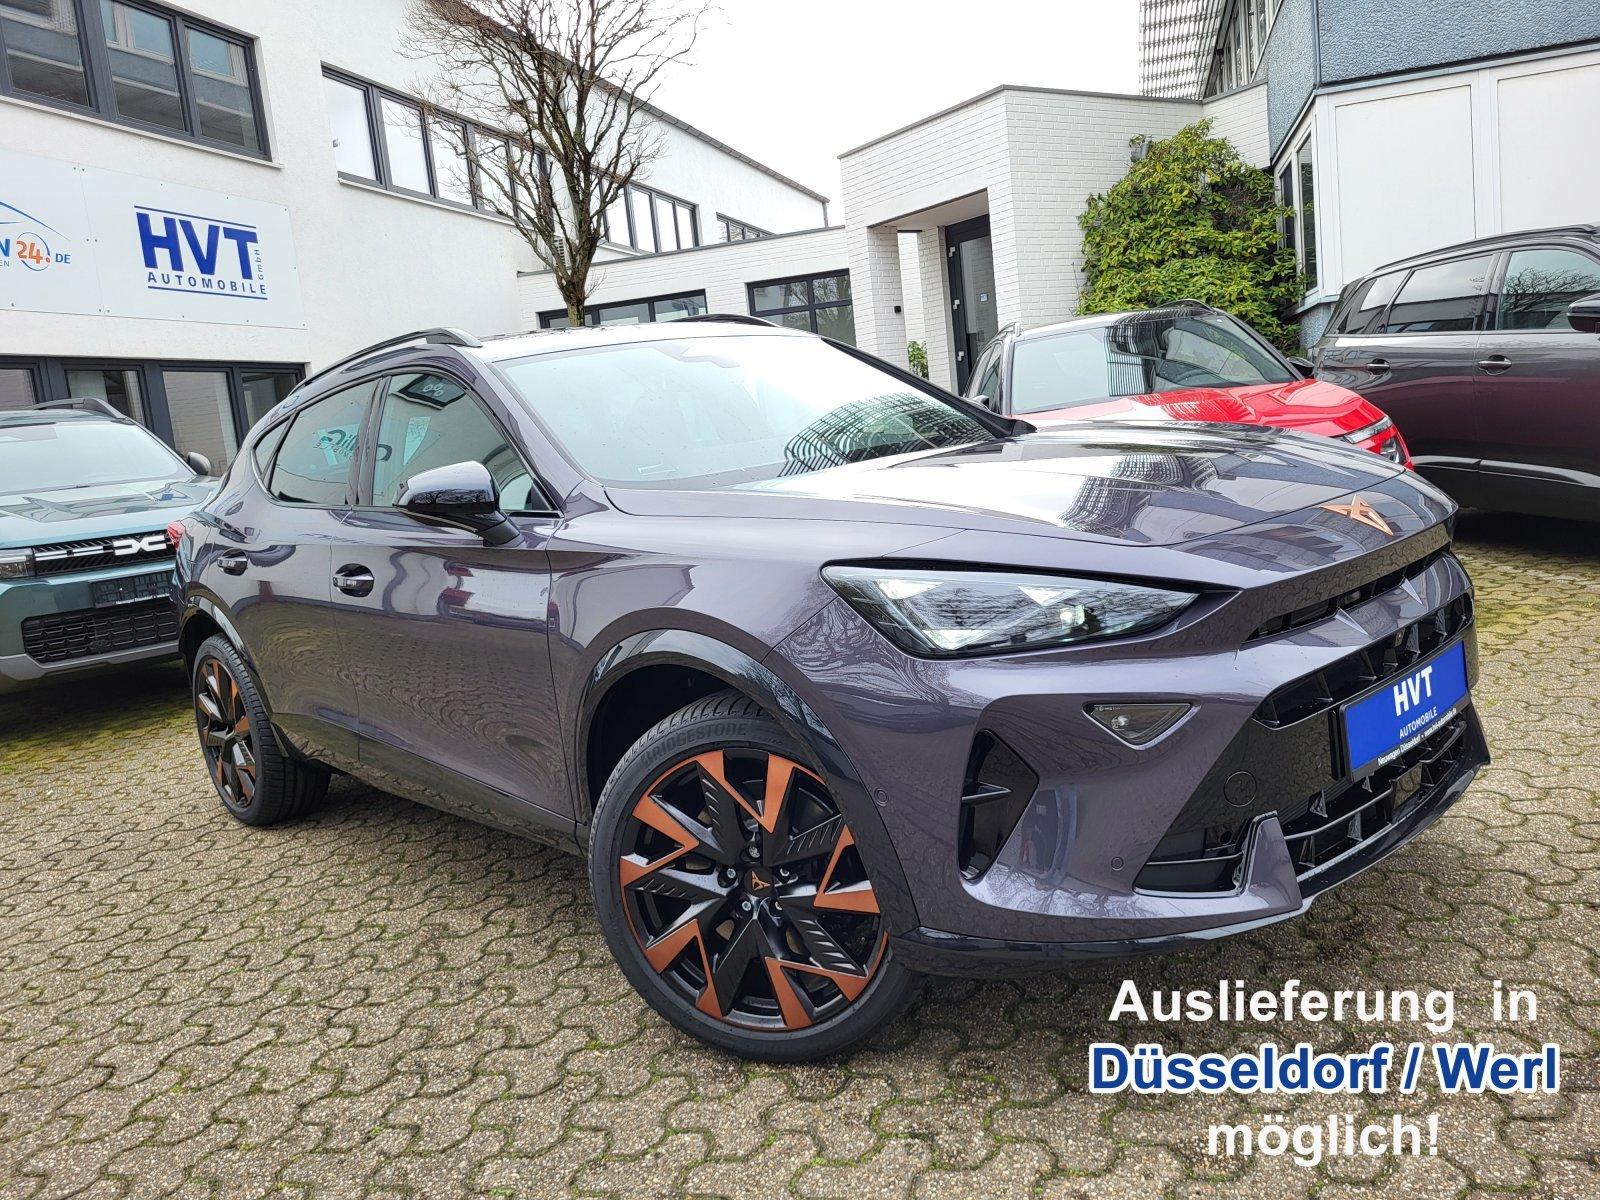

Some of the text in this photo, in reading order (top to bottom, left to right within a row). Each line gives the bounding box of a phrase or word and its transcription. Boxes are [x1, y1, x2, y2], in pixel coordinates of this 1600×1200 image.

[136, 212, 258, 280] HVT
[148, 271, 267, 295] AUTOMOBILE
[1393, 665, 1433, 717] HVT
[1399, 706, 1438, 739] AUTOMOBILE
